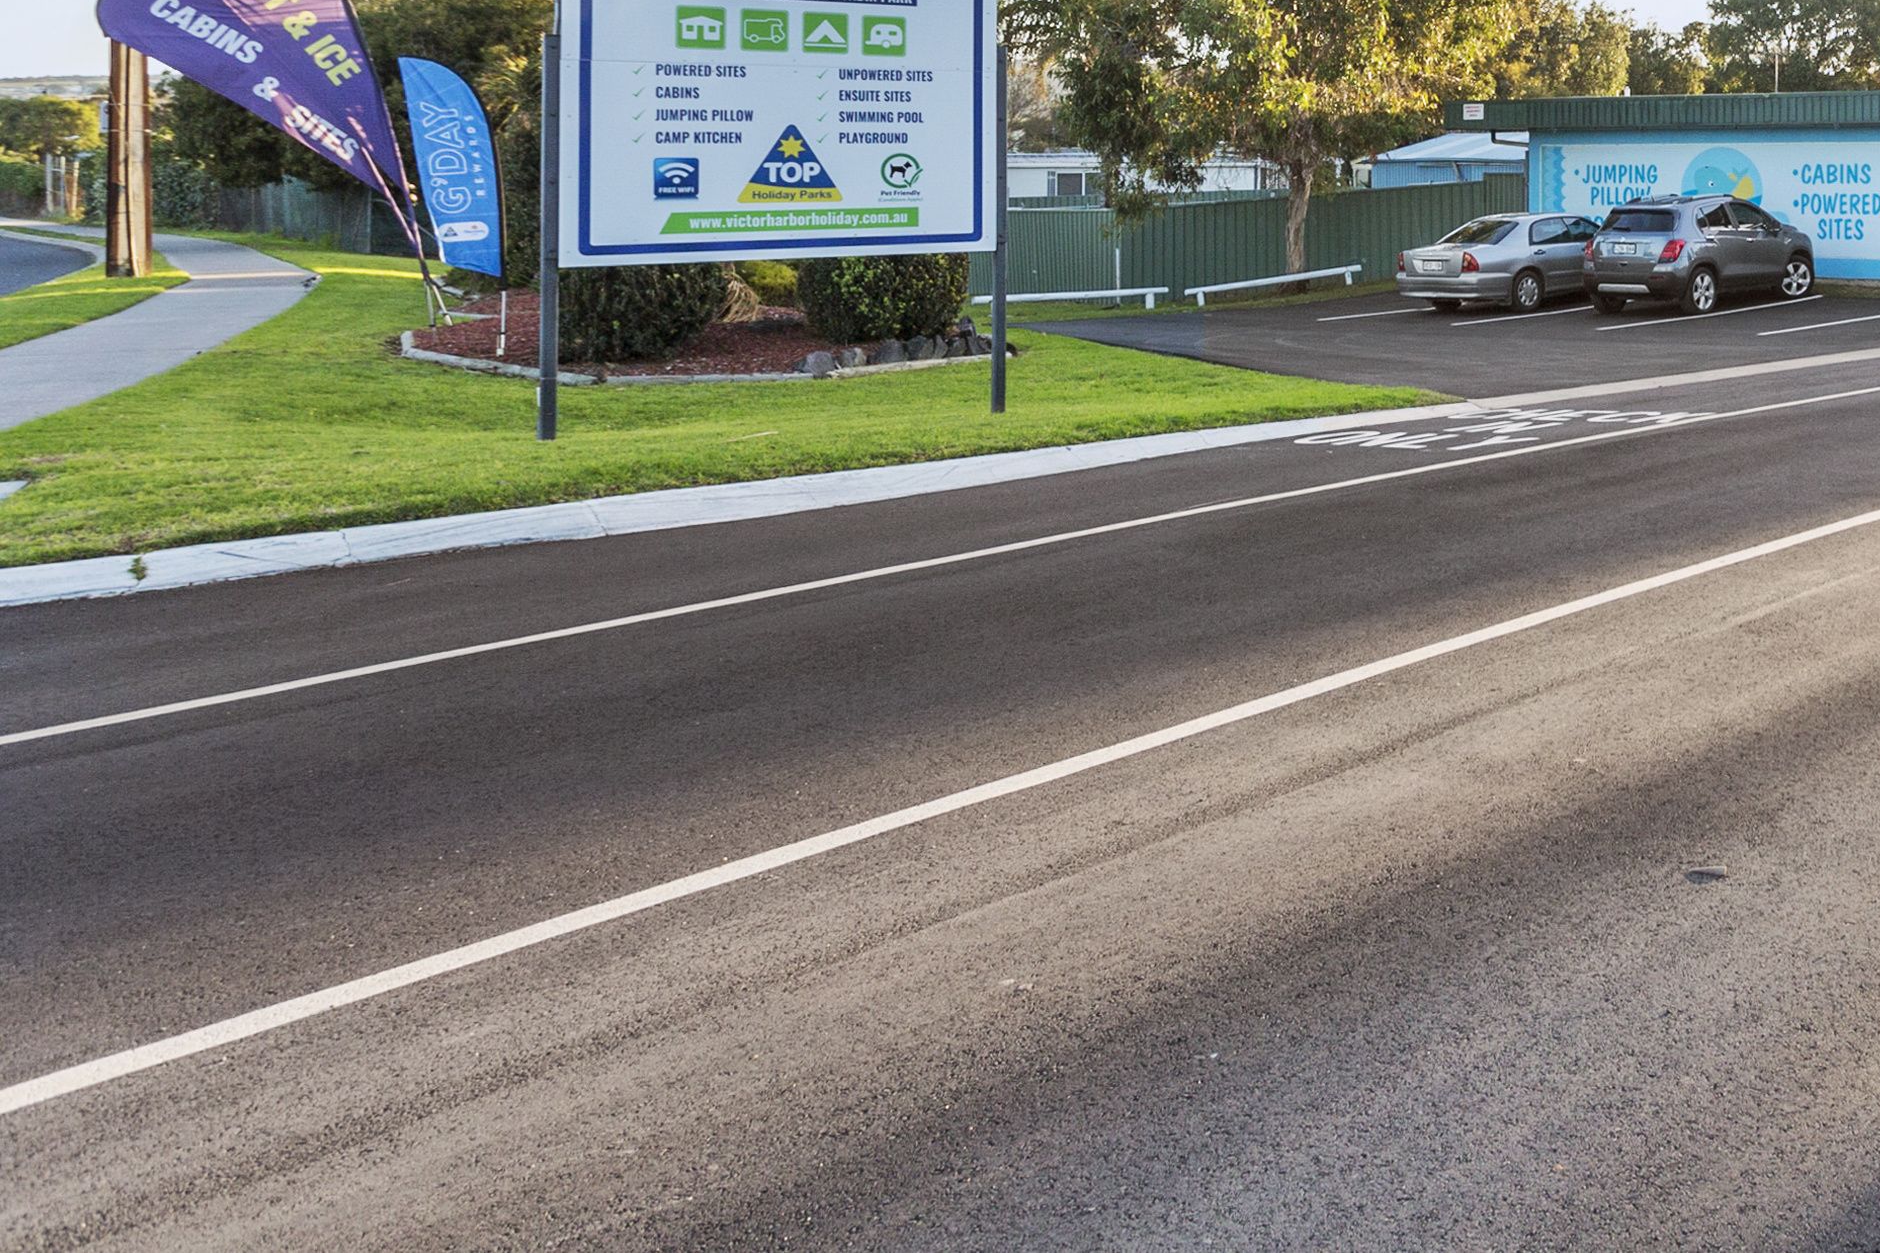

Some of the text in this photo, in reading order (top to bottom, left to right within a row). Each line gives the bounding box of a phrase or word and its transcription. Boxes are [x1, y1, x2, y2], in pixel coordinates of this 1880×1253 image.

[283, 11, 318, 41] &
[304, 33, 362, 87] ICE
[656, 63, 747, 78] POWERED SITES
[838, 68, 933, 83] UNPOWERED SITES
[253, 76, 281, 103] &
[656, 86, 700, 100] CABINS
[838, 89, 912, 103] ENSUITE SITES
[655, 108, 754, 123] JUMPING PILLOW
[838, 110, 924, 124] SWIMMING POOL
[284, 105, 359, 162] SITES
[656, 131, 743, 145] CAMP KITCHEN
[838, 131, 908, 145] PLAYGROUND
[420, 101, 472, 214] G'DAY
[464, 114, 485, 197] REWARDS
[763, 161, 821, 184] TOP
[1582, 164, 1658, 184] JUMPING
[1801, 163, 1872, 185] CABINS
[752, 189, 832, 201] Holiday Parks
[893, 189, 920, 197] Friendly
[689, 212, 909, 229] www.victorharborholiday.com.au
[1817, 218, 1864, 240] SITES
[1449, 408, 1714, 424] CHECK
[1443, 421, 1563, 434] IN
[1293, 430, 1540, 451] ONLY
